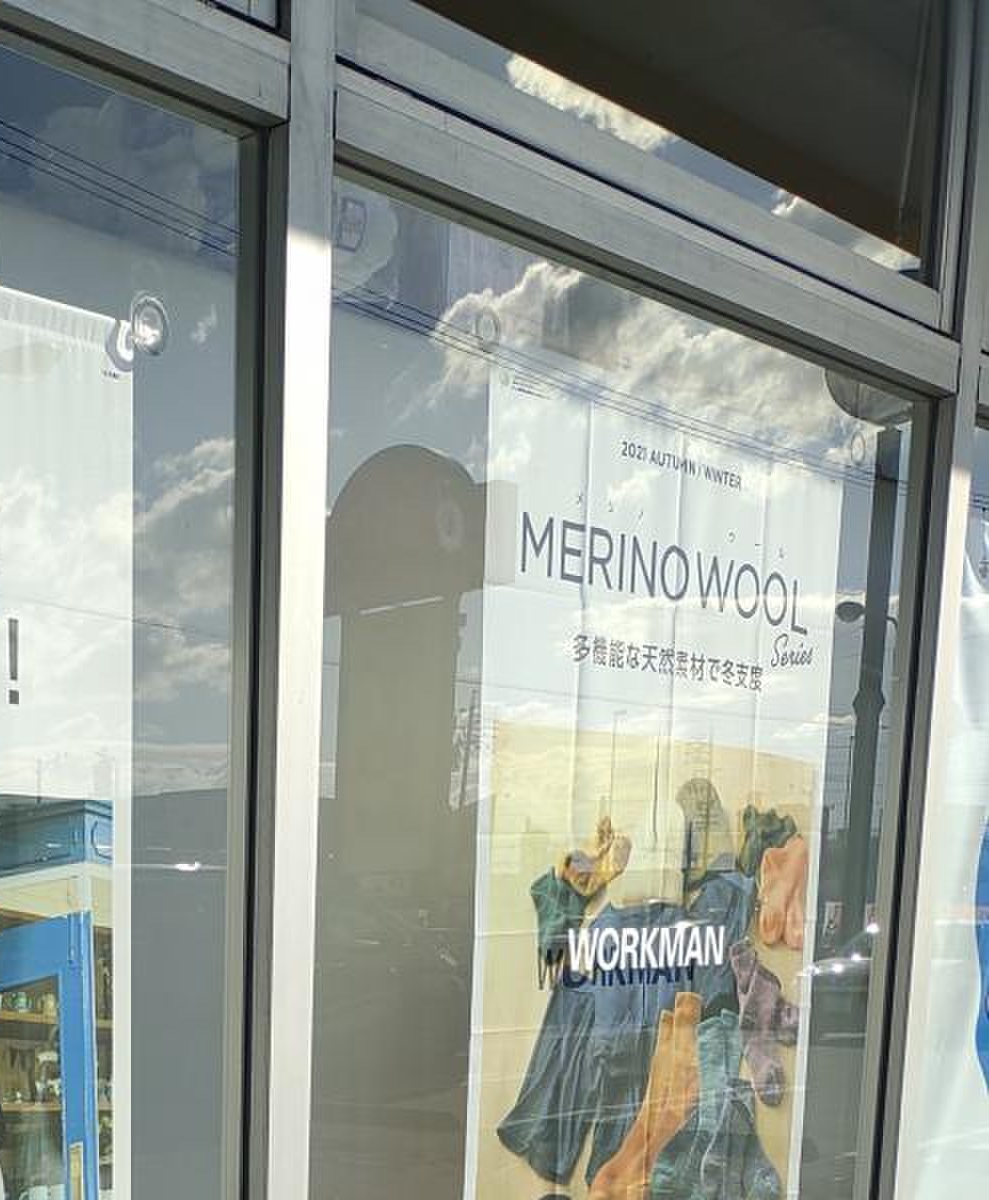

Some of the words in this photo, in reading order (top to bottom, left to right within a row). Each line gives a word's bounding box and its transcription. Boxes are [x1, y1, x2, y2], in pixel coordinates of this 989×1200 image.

[621, 441, 647, 461] 2021
[650, 450, 696, 475] AUTUMN
[702, 464, 742, 491] WINTER
[520, 511, 690, 600] MERINO
[697, 551, 808, 635] WOOL
[572, 634, 765, 691] 多機能な天然素材で冬支度
[771, 633, 814, 667] Series
[568, 925, 726, 972] WORKMAN
